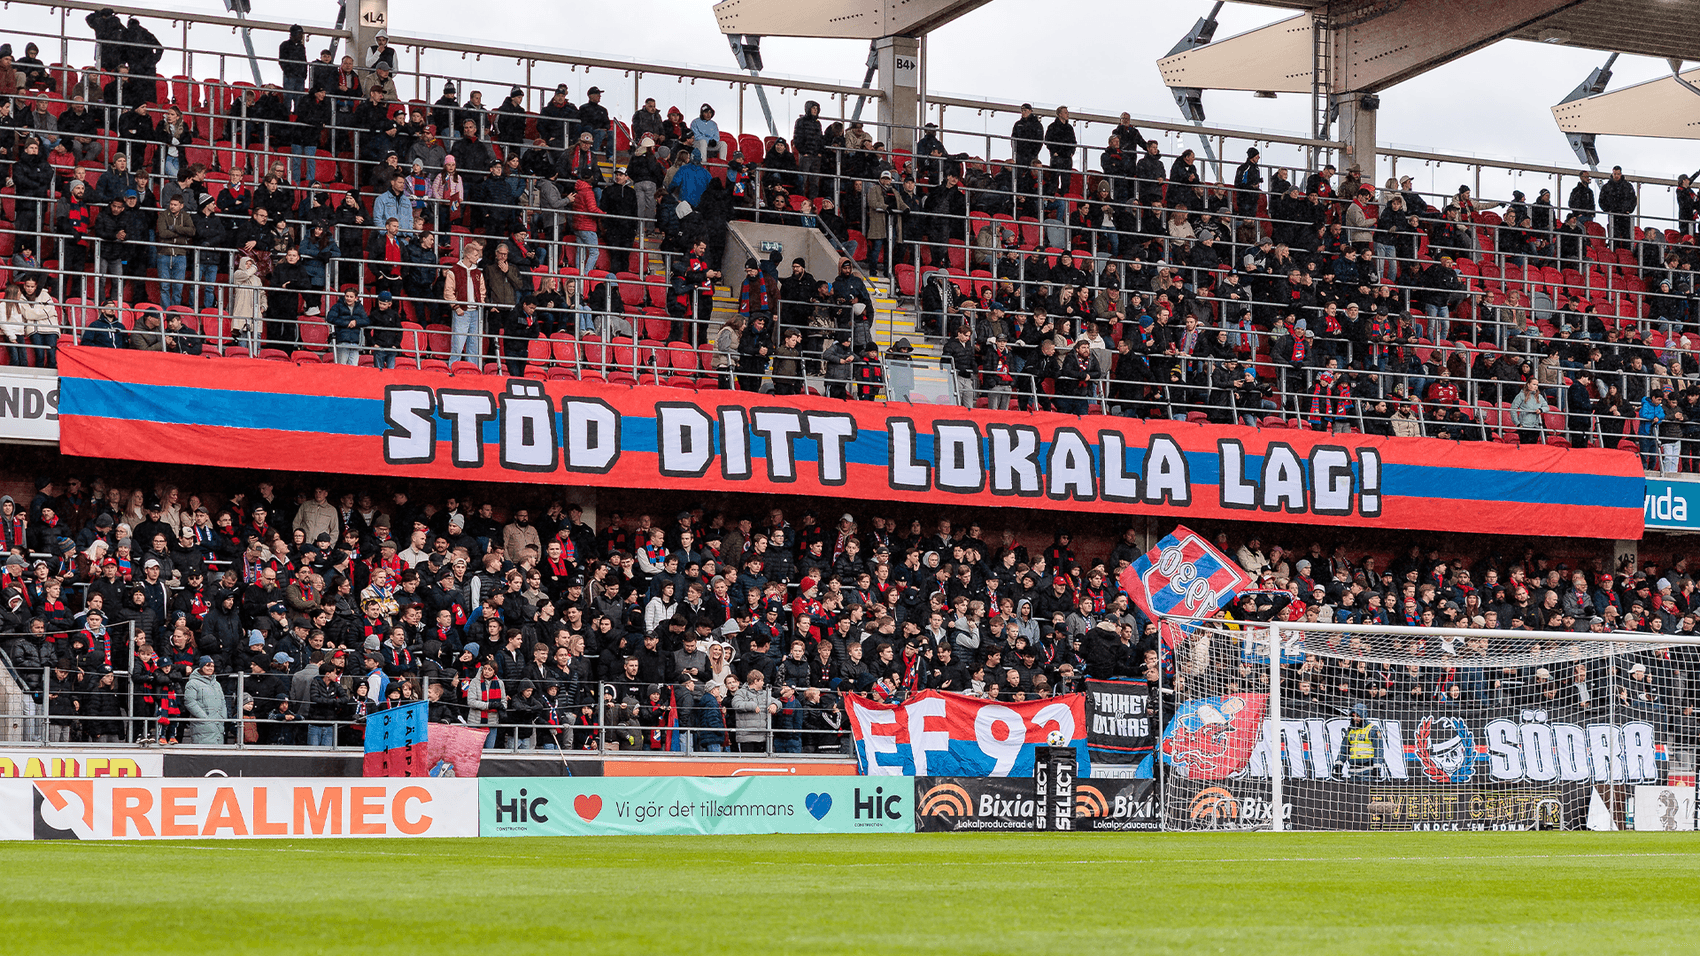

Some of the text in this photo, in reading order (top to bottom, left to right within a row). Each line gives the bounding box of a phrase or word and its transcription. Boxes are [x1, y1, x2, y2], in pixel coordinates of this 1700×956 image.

[369, 12, 386, 24] L4
[896, 58, 910, 70] B4
[383, 378, 1382, 518] STÖD DITT LOKALA LAG!
[1092, 692, 1148, 715] FRIHET
[1092, 714, 1149, 737] ULTRAS
[383, 715, 392, 777] ÖSTE
[1230, 709, 1658, 785] ATION SÖDRA
[978, 793, 1035, 817] Bixia
[1036, 762, 1048, 829] SELECT
[1055, 762, 1072, 830] SELECT
[111, 786, 433, 837] REALMEC
[616, 800, 795, 822] Vi gör det tillsammans
[1243, 797, 1293, 819] Bixa
[958, 819, 1026, 829] Lokalproducerad
[1413, 823, 1459, 832] KNOCK
[1493, 823, 1525, 832] DOWN
